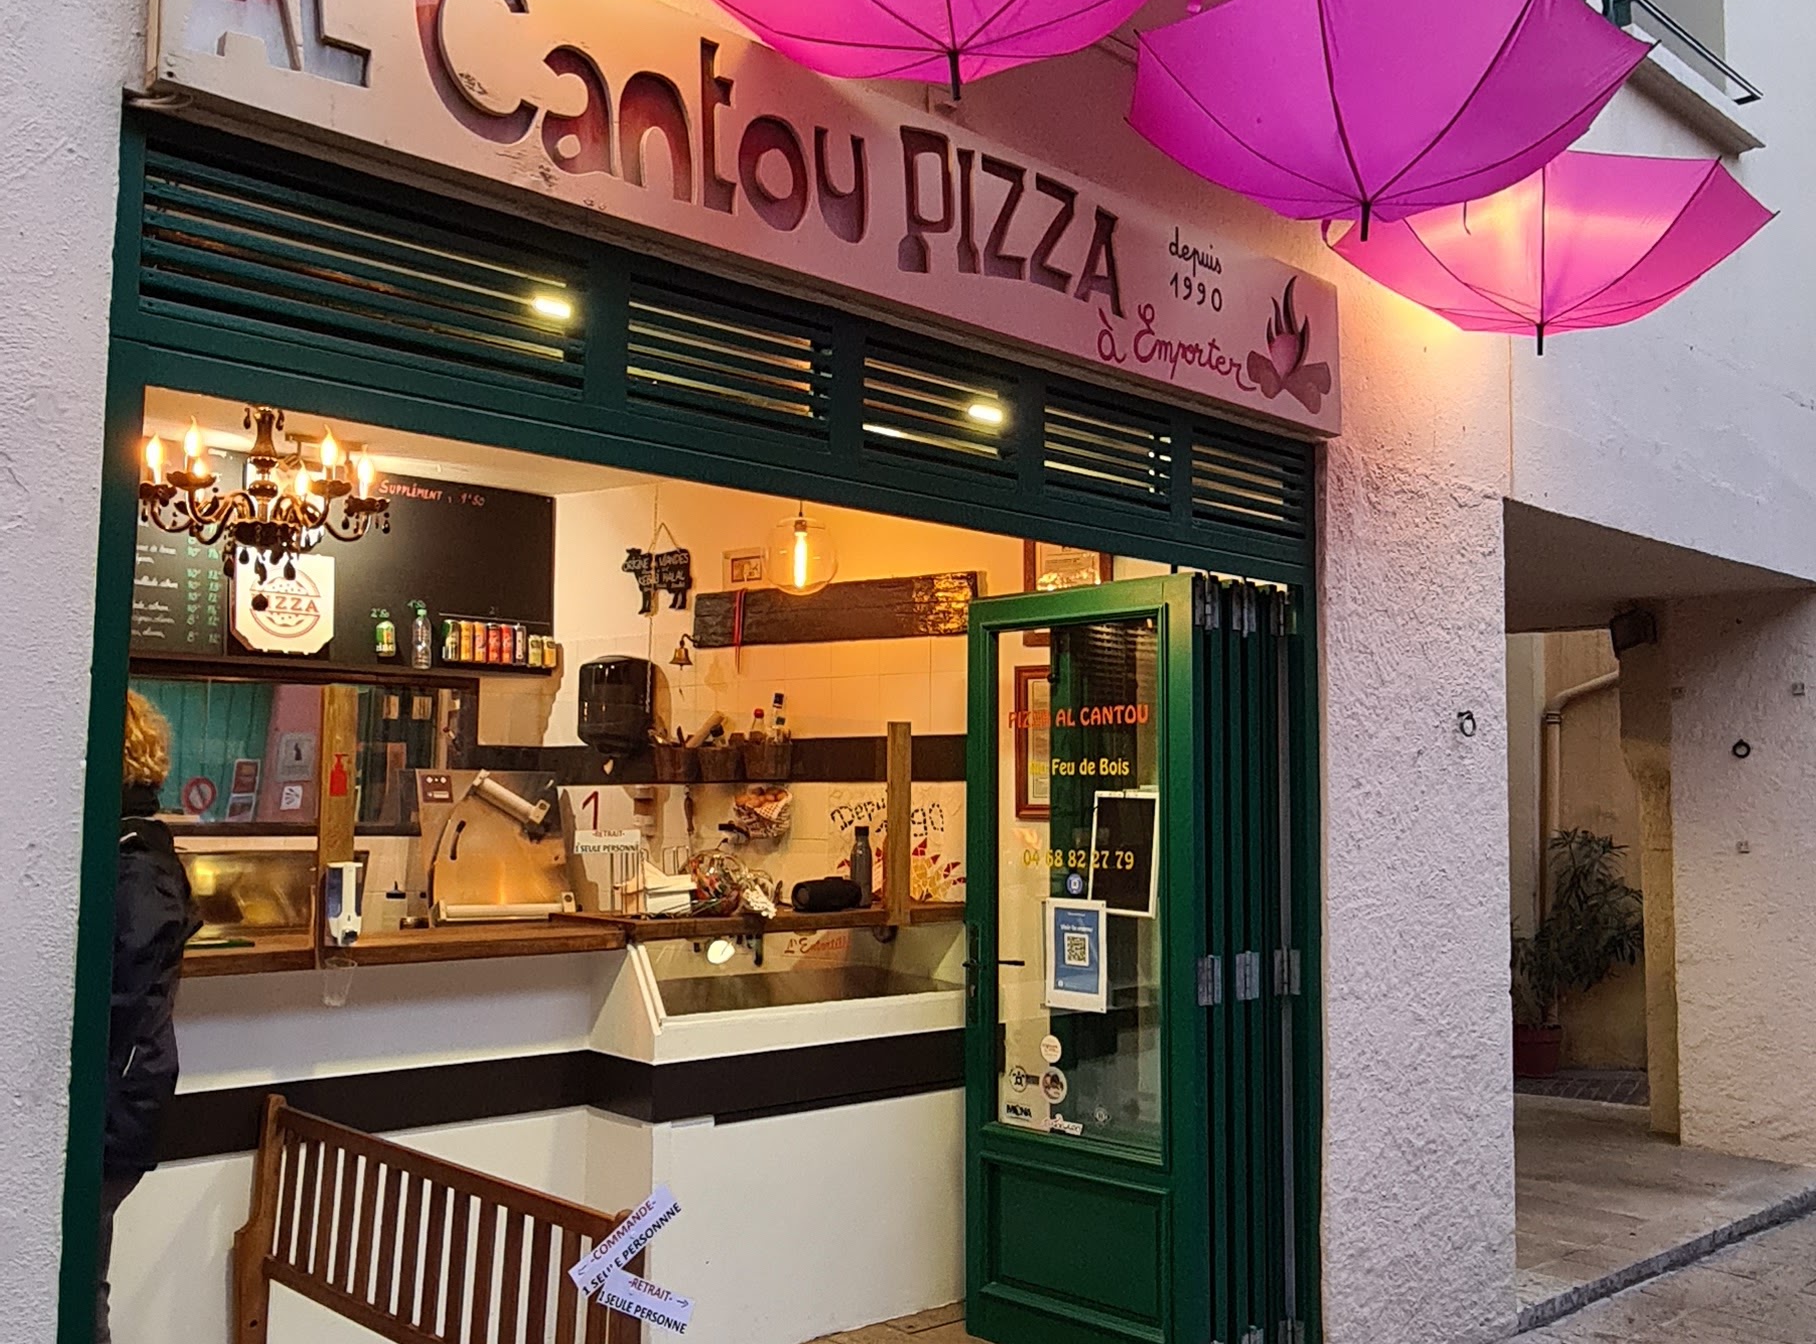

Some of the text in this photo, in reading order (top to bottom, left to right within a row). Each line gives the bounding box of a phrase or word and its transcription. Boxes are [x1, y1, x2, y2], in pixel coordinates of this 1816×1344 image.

[898, 125, 1126, 318] PIZZA
[1169, 226, 1222, 277] depuis
[1170, 272, 1223, 312] 1990
[1097, 304, 1257, 391] à Emporter
[252, 593, 319, 613] ZZA
[1055, 708, 1076, 728] AL
[1079, 704, 1149, 726] CANTOU
[1051, 758, 1075, 776] Feu
[1079, 758, 1096, 775] de
[1099, 758, 1130, 776] Bois
[582, 790, 599, 830] 1
[830, 798, 888, 832] Depu
[1045, 849, 1063, 866] 68
[1067, 850, 1086, 868] 82
[1092, 850, 1109, 869] 27
[1114, 850, 1135, 870] 79
[606, 1292, 633, 1313] SEULE
[633, 1305, 688, 1335] PERSONNE
